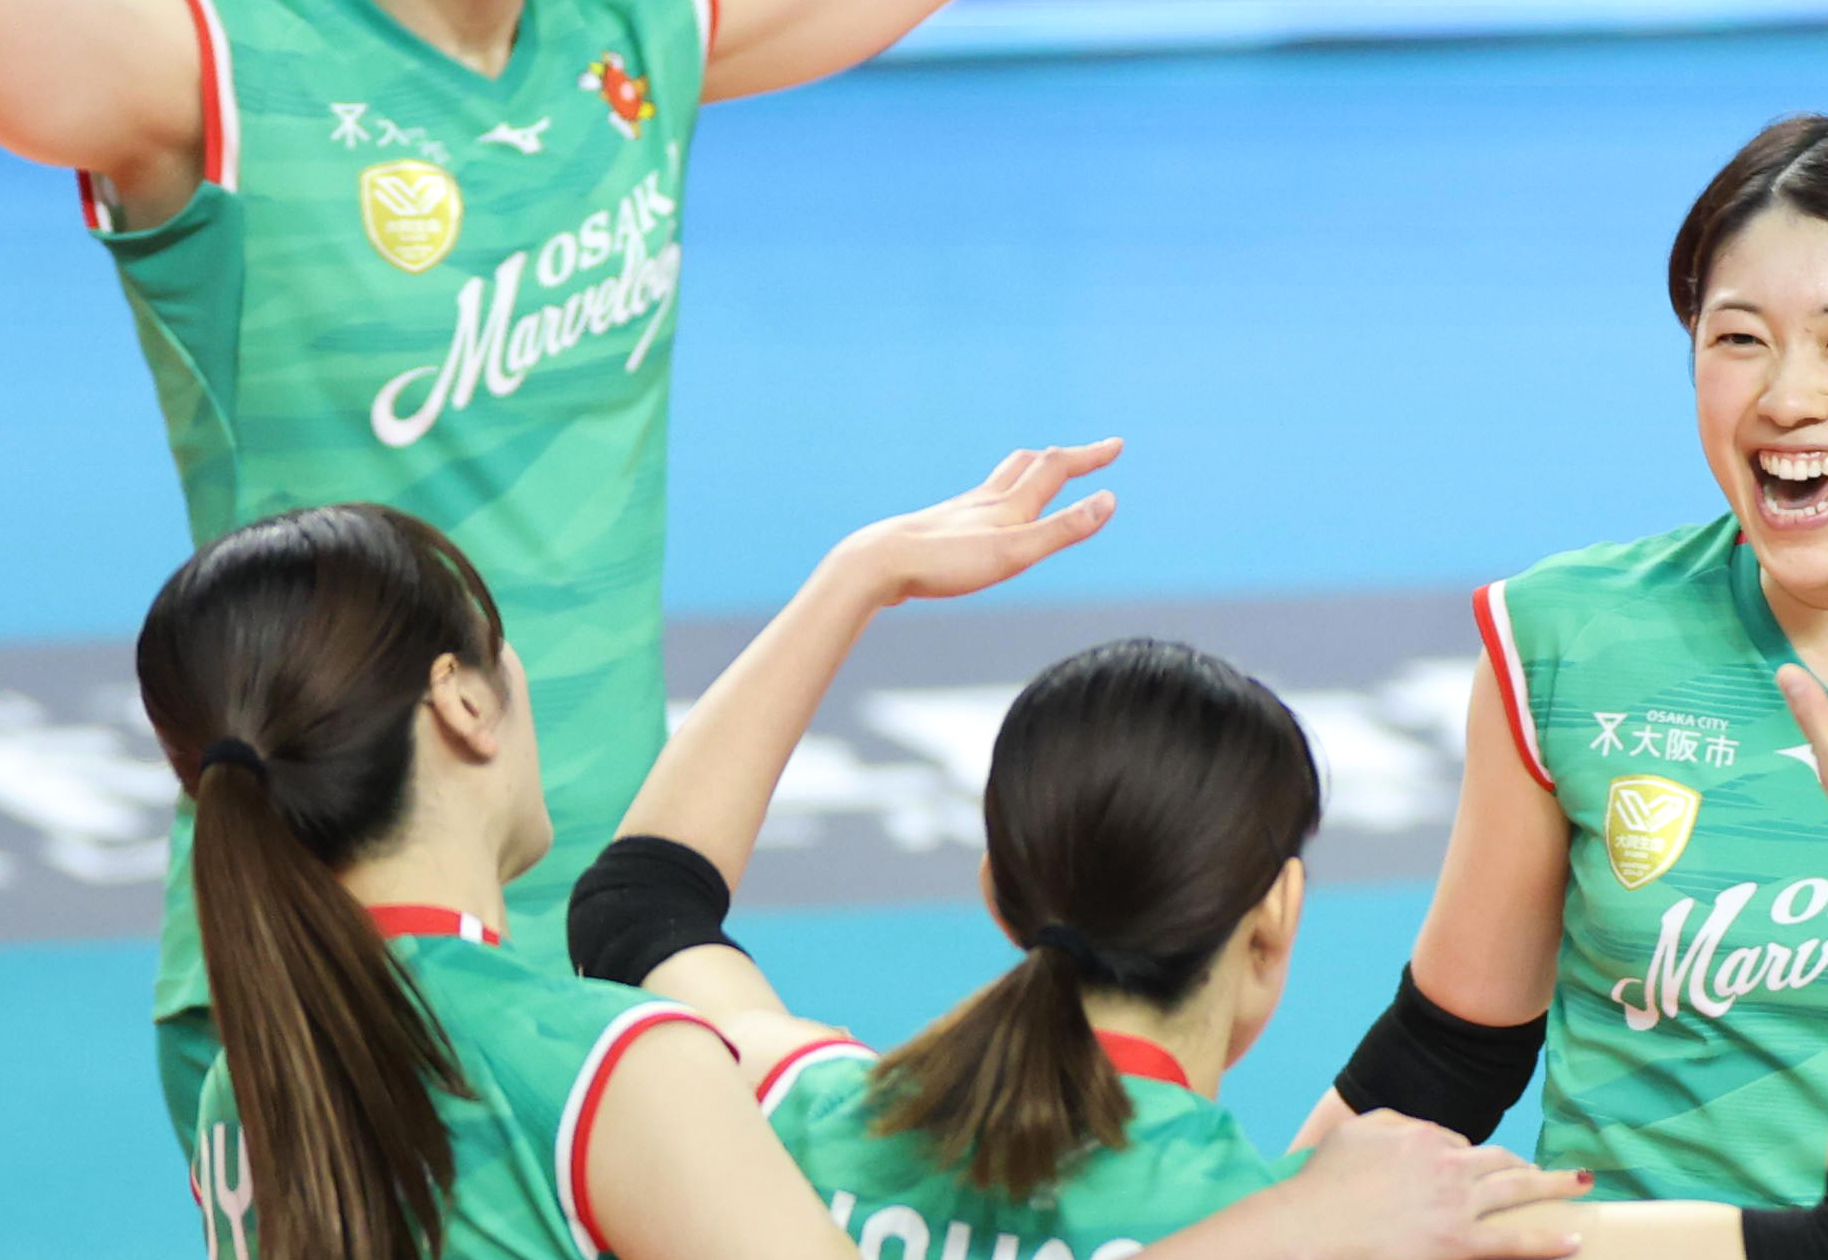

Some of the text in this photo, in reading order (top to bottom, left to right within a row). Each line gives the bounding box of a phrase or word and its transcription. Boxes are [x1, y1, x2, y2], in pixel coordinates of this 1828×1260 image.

[537, 171, 676, 288] OSAK
[1646, 709, 1730, 732] OSAKA CITY
[1629, 725, 1740, 768] 大阪市
